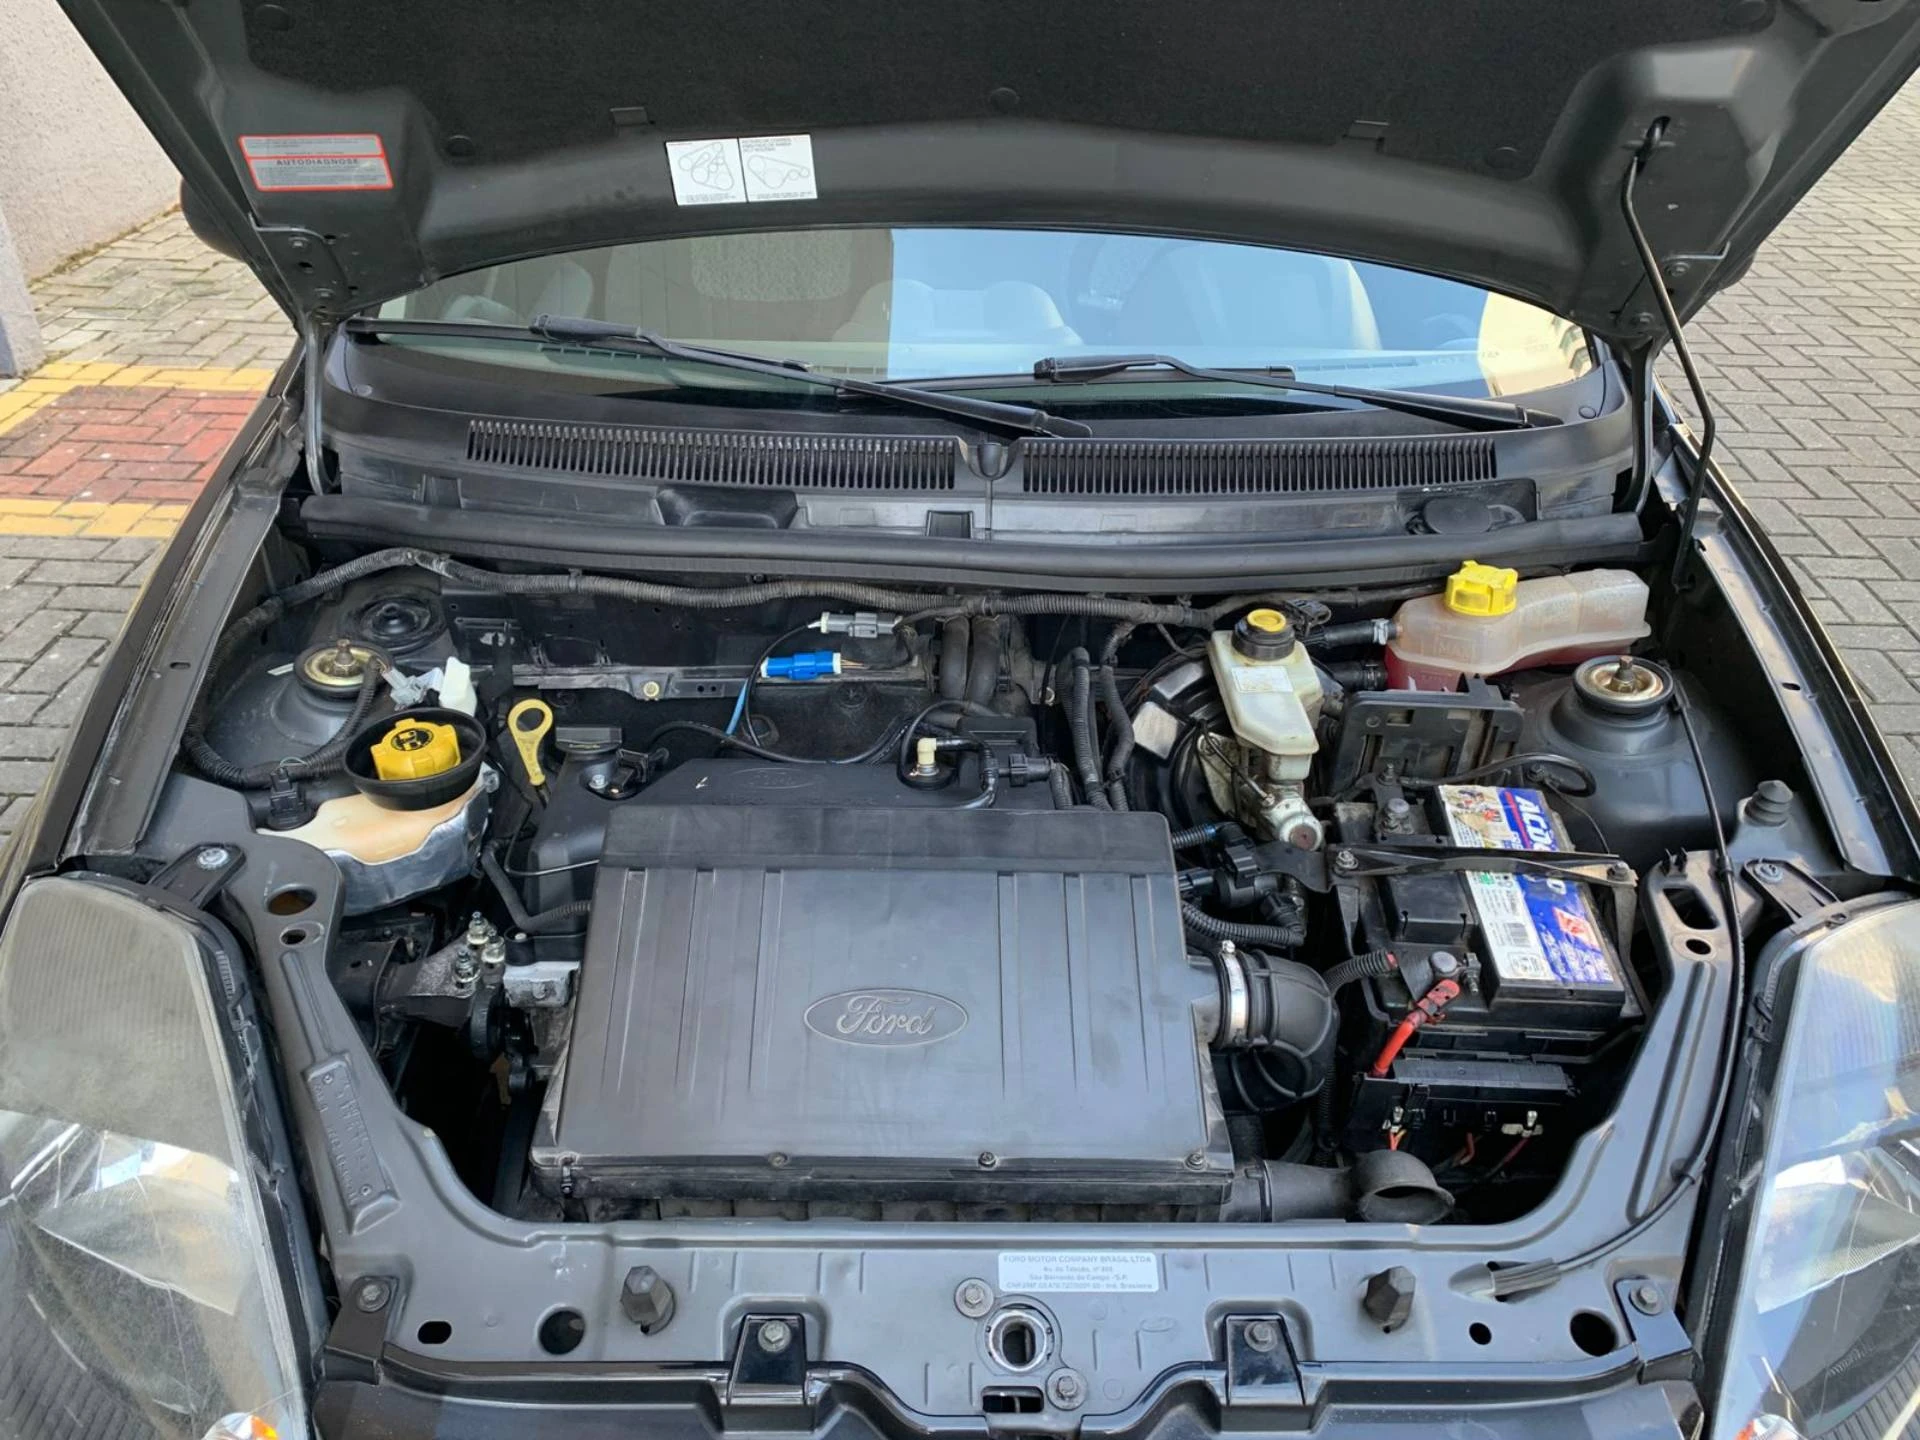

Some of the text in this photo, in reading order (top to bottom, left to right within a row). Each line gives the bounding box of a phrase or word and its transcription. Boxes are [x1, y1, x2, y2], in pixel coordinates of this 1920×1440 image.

[276, 158, 359, 166] AUTODIAGNOSE
[836, 995, 937, 1034] Ford
[1003, 1255, 1026, 1263] FORD
[1028, 1255, 1057, 1263] MOTOR
[1058, 1255, 1098, 1263] COMPANY
[1099, 1255, 1129, 1263] BRASIL
